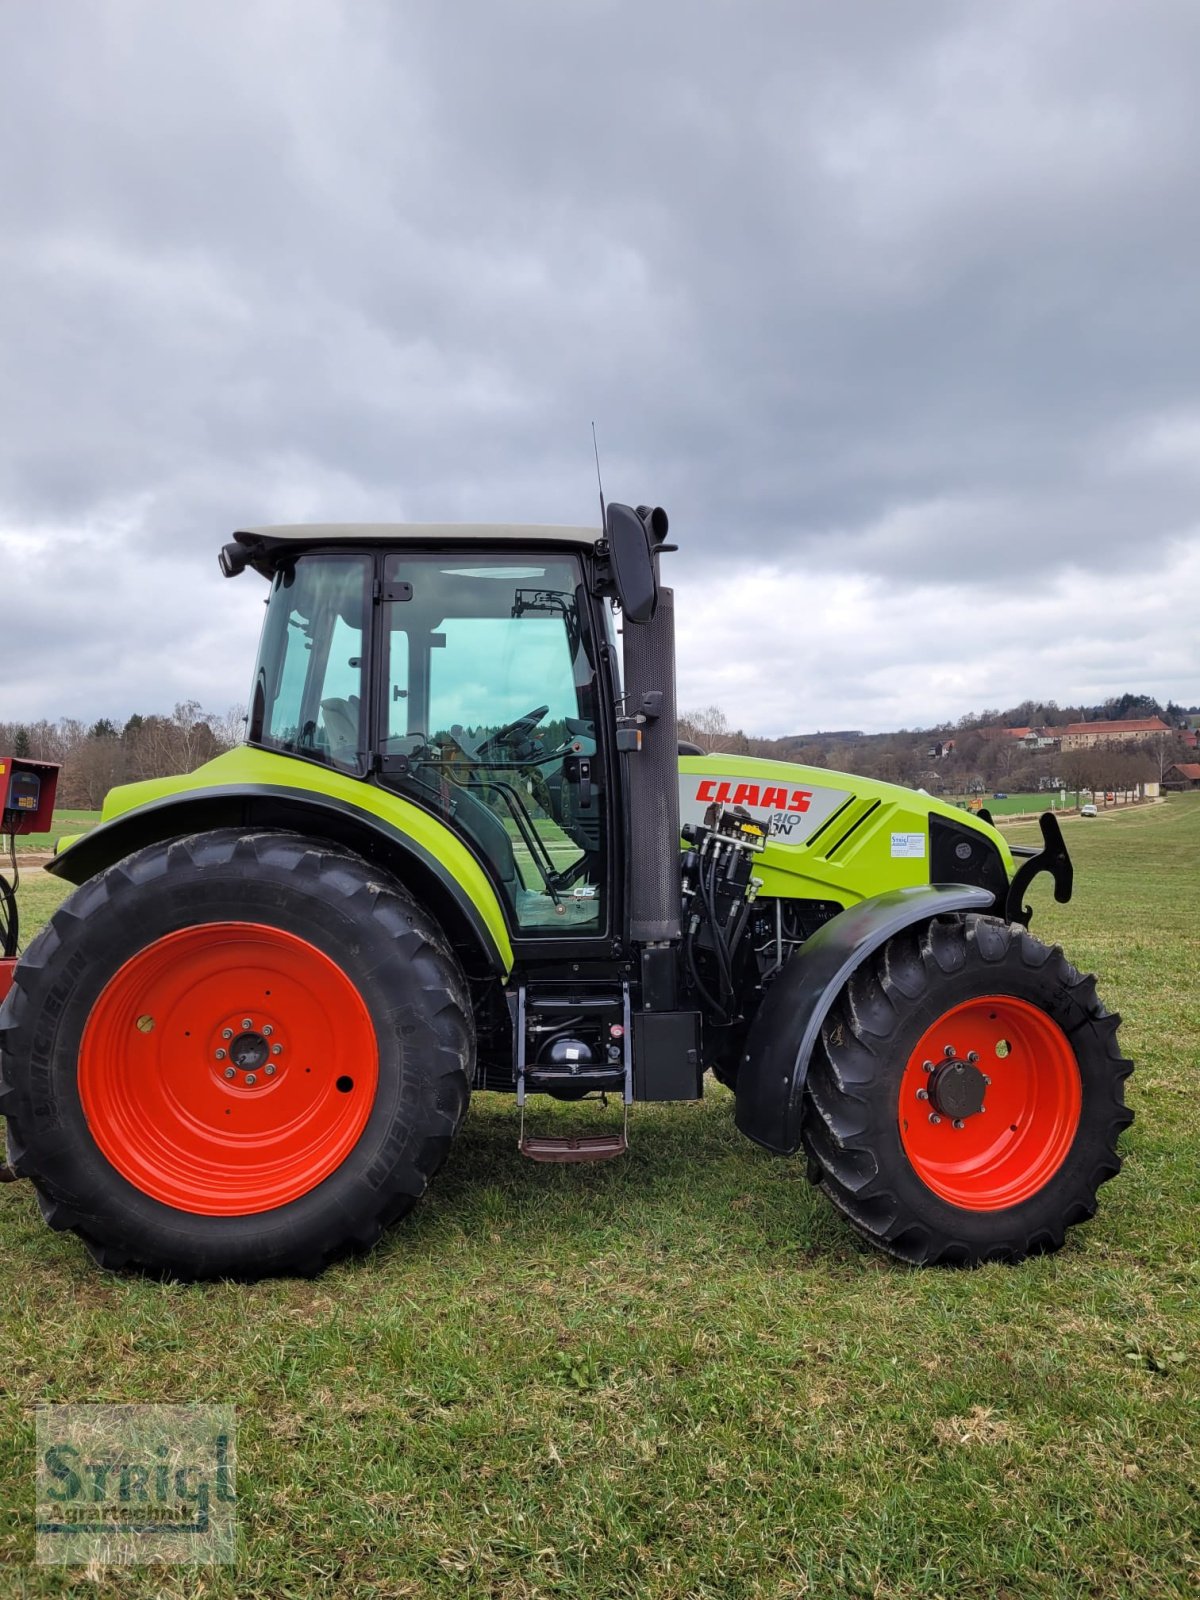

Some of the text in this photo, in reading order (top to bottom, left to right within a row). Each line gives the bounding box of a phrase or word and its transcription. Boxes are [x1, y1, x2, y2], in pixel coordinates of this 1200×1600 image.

[695, 780, 813, 813] CLAAS
[29, 950, 88, 1097] MICHELIN
[361, 1042, 421, 1191] MICHELIN
